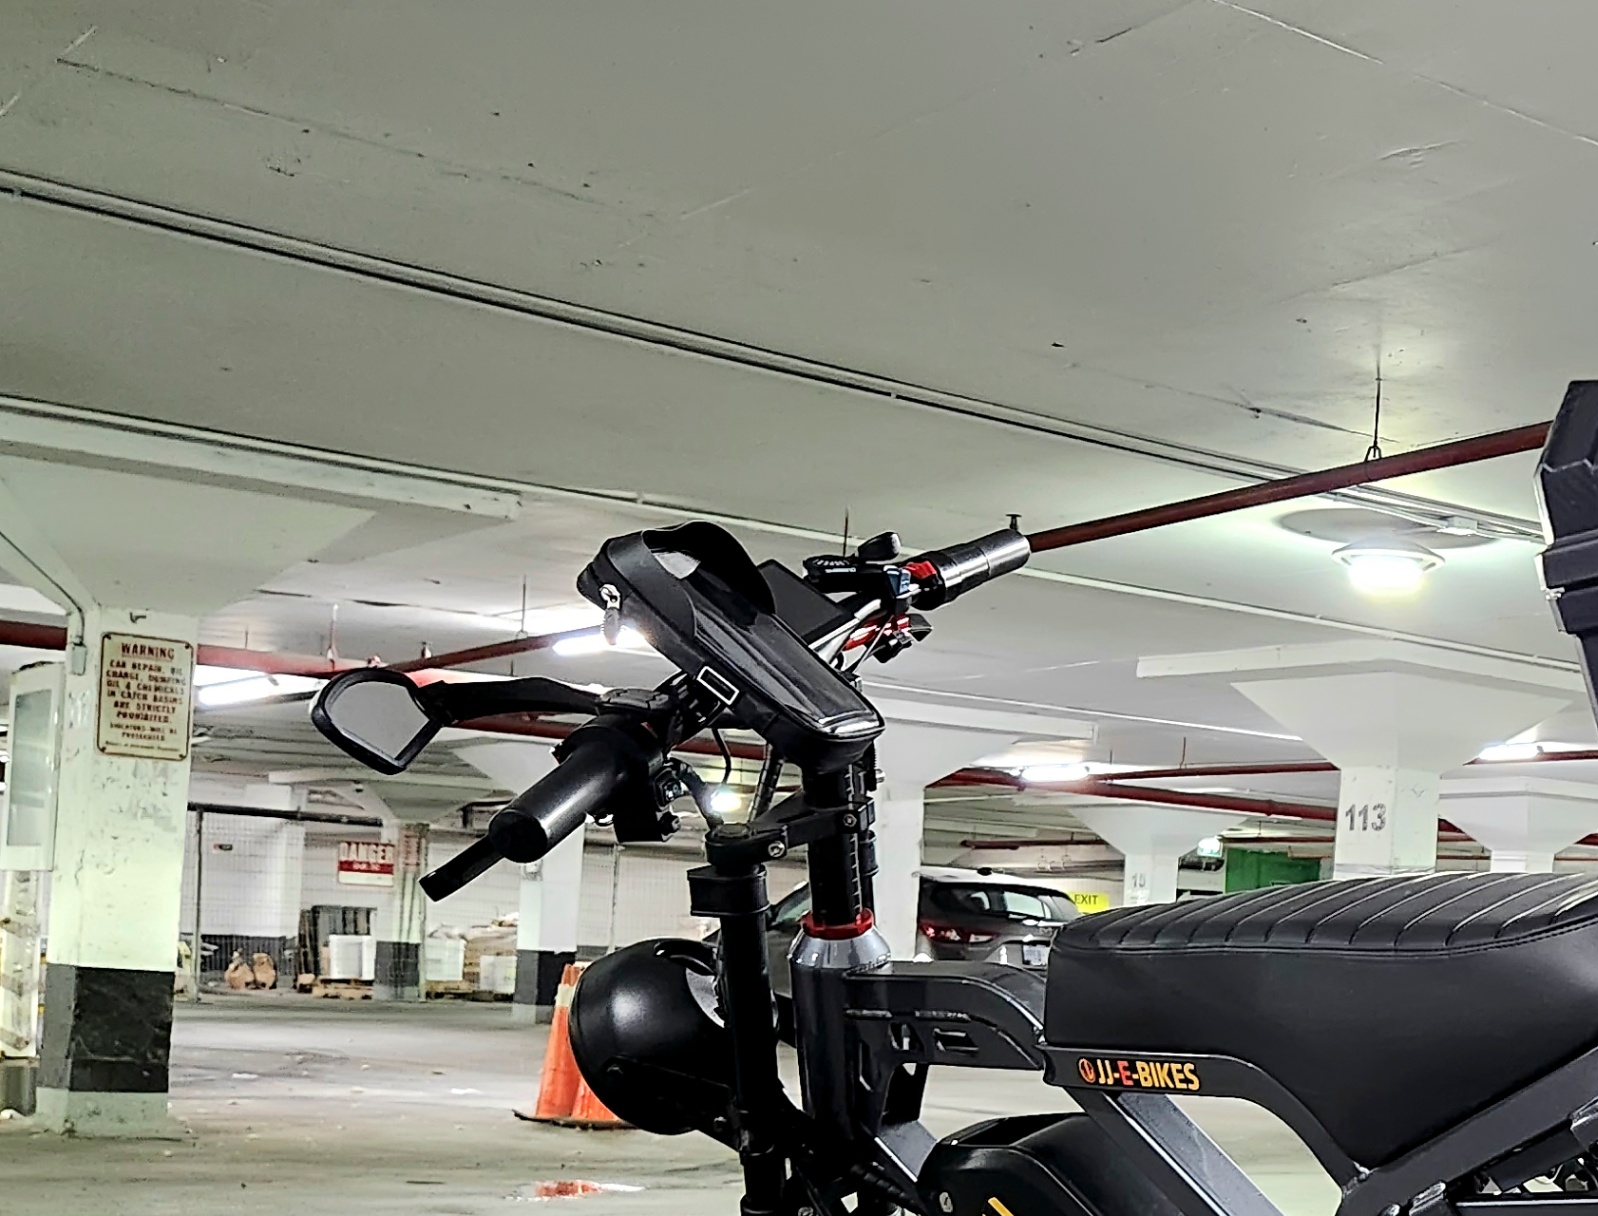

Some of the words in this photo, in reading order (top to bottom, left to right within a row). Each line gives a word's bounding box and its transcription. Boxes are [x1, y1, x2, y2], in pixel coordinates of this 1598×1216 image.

[121, 642, 175, 660] WARNING
[1345, 803, 1387, 832] 113
[339, 841, 394, 864] DANGER
[1074, 893, 1099, 905] EXIT
[1096, 1058, 1200, 1091] JJ-E-BIKES
